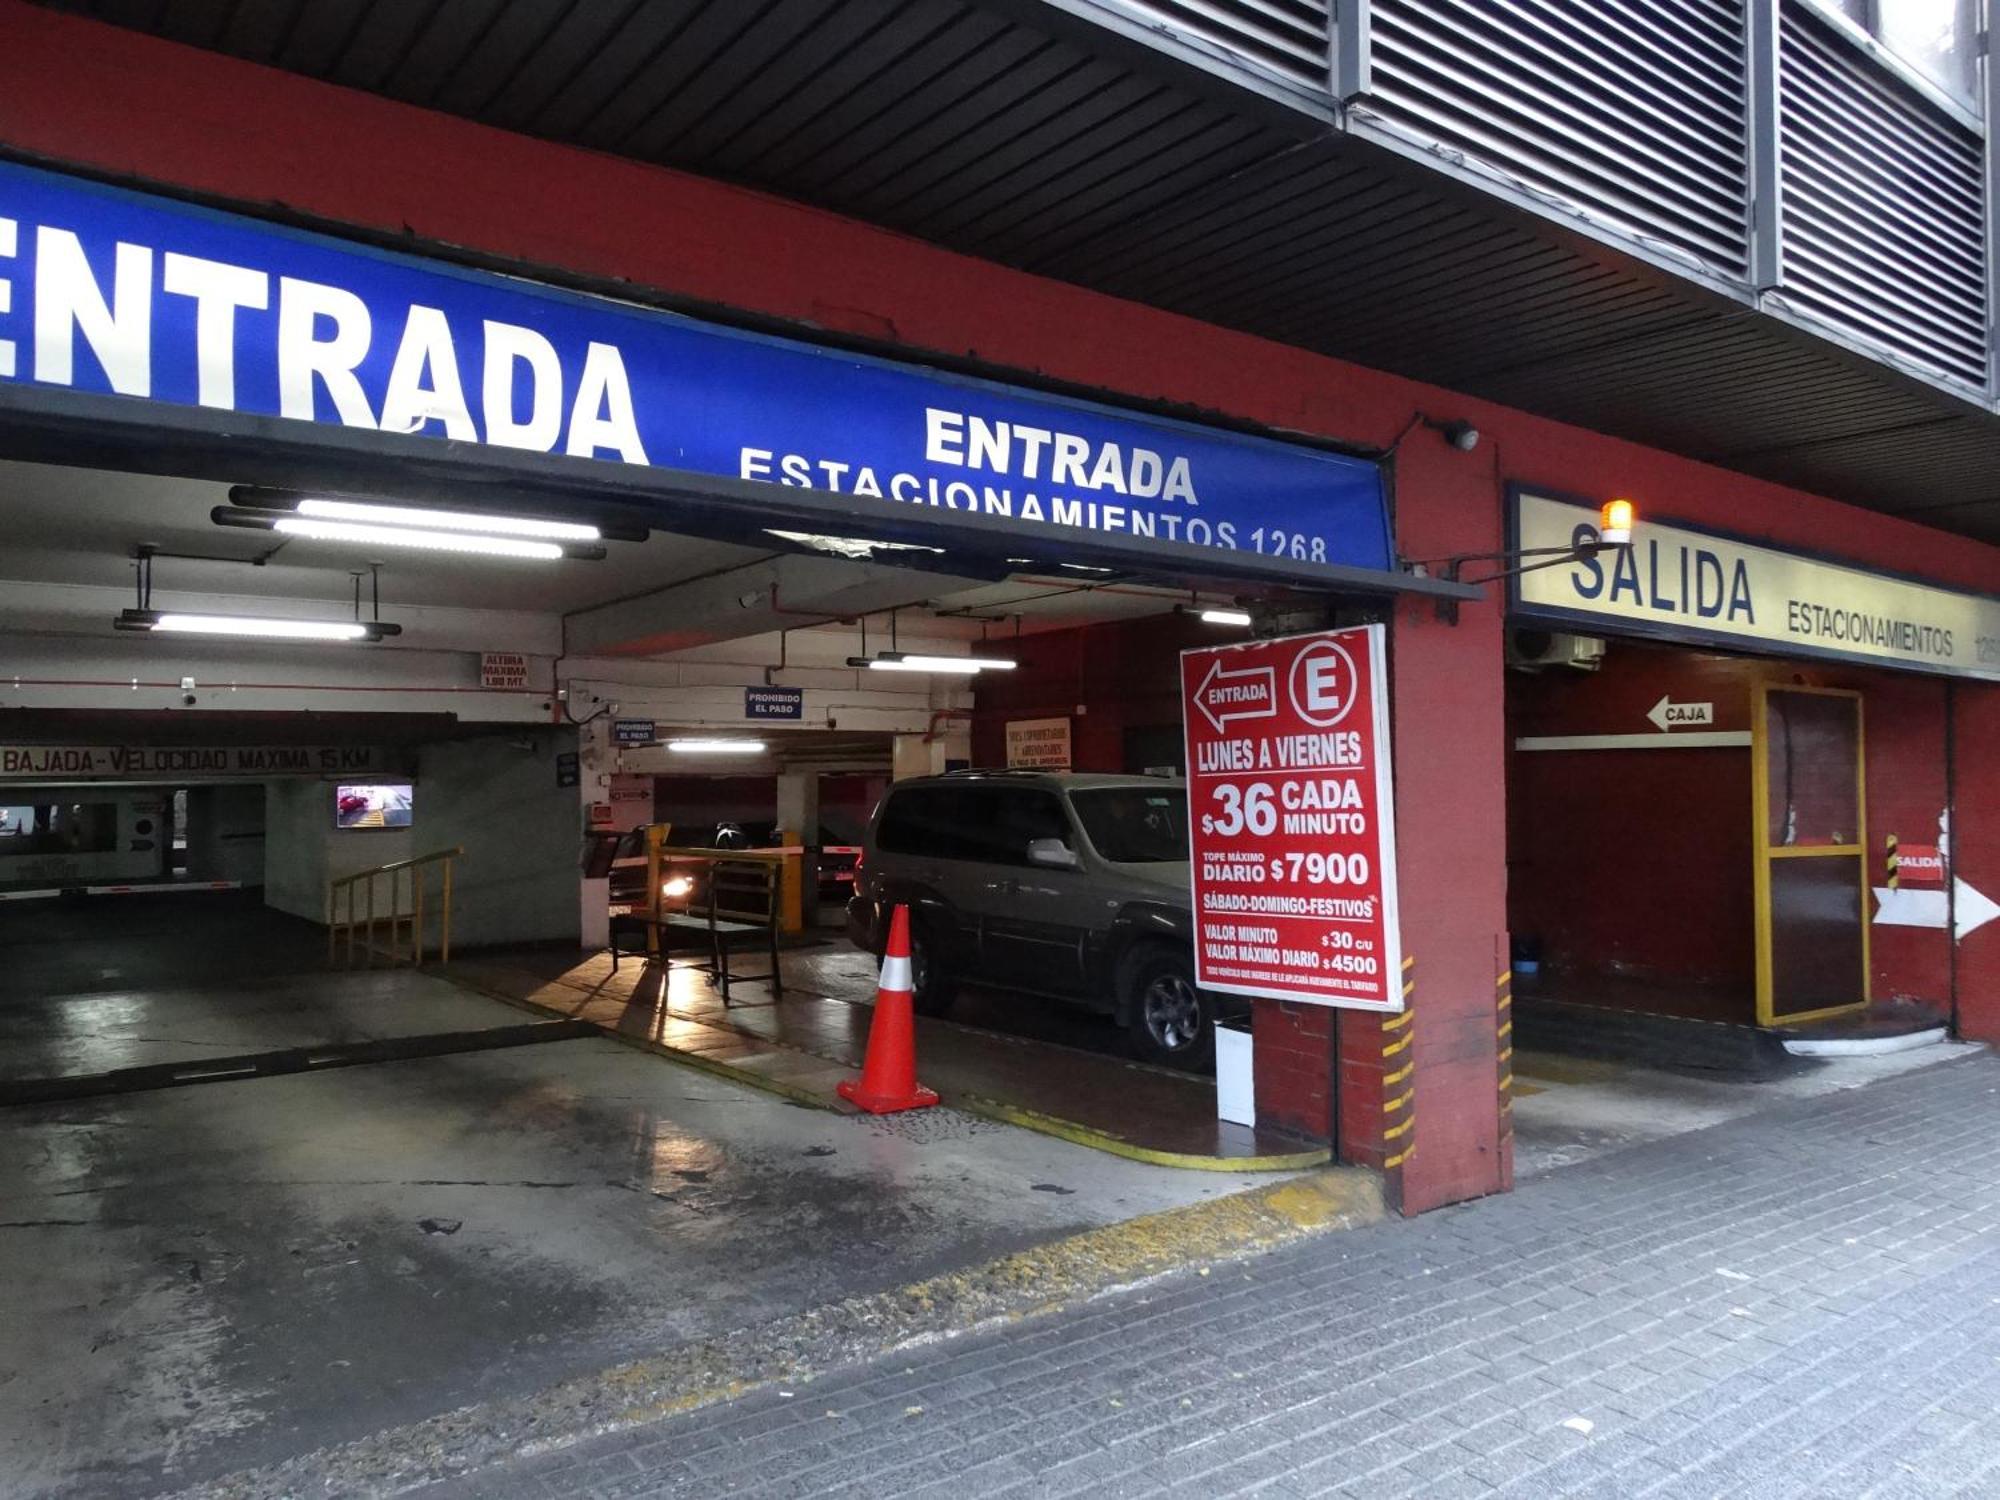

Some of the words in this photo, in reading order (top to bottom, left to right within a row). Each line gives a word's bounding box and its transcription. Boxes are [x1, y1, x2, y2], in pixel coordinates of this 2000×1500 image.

[0, 216, 649, 466] NTRADA
[926, 407, 1198, 505] ENTRADA
[740, 447, 1236, 551] ESTACIONAMIENTOS
[1251, 527, 1326, 563] 1268
[1571, 523, 1755, 624] SALIDA
[1788, 600, 1952, 656] ESTACIONAMIENTOS
[1209, 683, 1268, 705] ENTRADA
[1306, 656, 1339, 711] E
[749, 694, 800, 703] PROHIBIDO
[755, 704, 767, 713] EL
[769, 704, 793, 713] PASO
[1665, 707, 1706, 721] CAJA
[1198, 738, 1254, 772] LUNES
[1259, 738, 1272, 769] A
[1275, 731, 1362, 768] VIERNES
[1202, 782, 1277, 837] $36
[1281, 779, 1364, 810] CADA
[1283, 813, 1366, 835] MINUTO
[1203, 852, 1225, 862] TOPE
[1227, 850, 1265, 862] MÁXIMO
[1896, 856, 1942, 868] SALIDA
[1203, 864, 1266, 882] DIARIO
[1204, 924, 1236, 942] VALOR
[1238, 926, 1277, 944] MINUTO
[1205, 943, 1237, 961] VALOR
[1239, 944, 1280, 965] MÁXIMO
[1282, 950, 1319, 968] DIARIO
